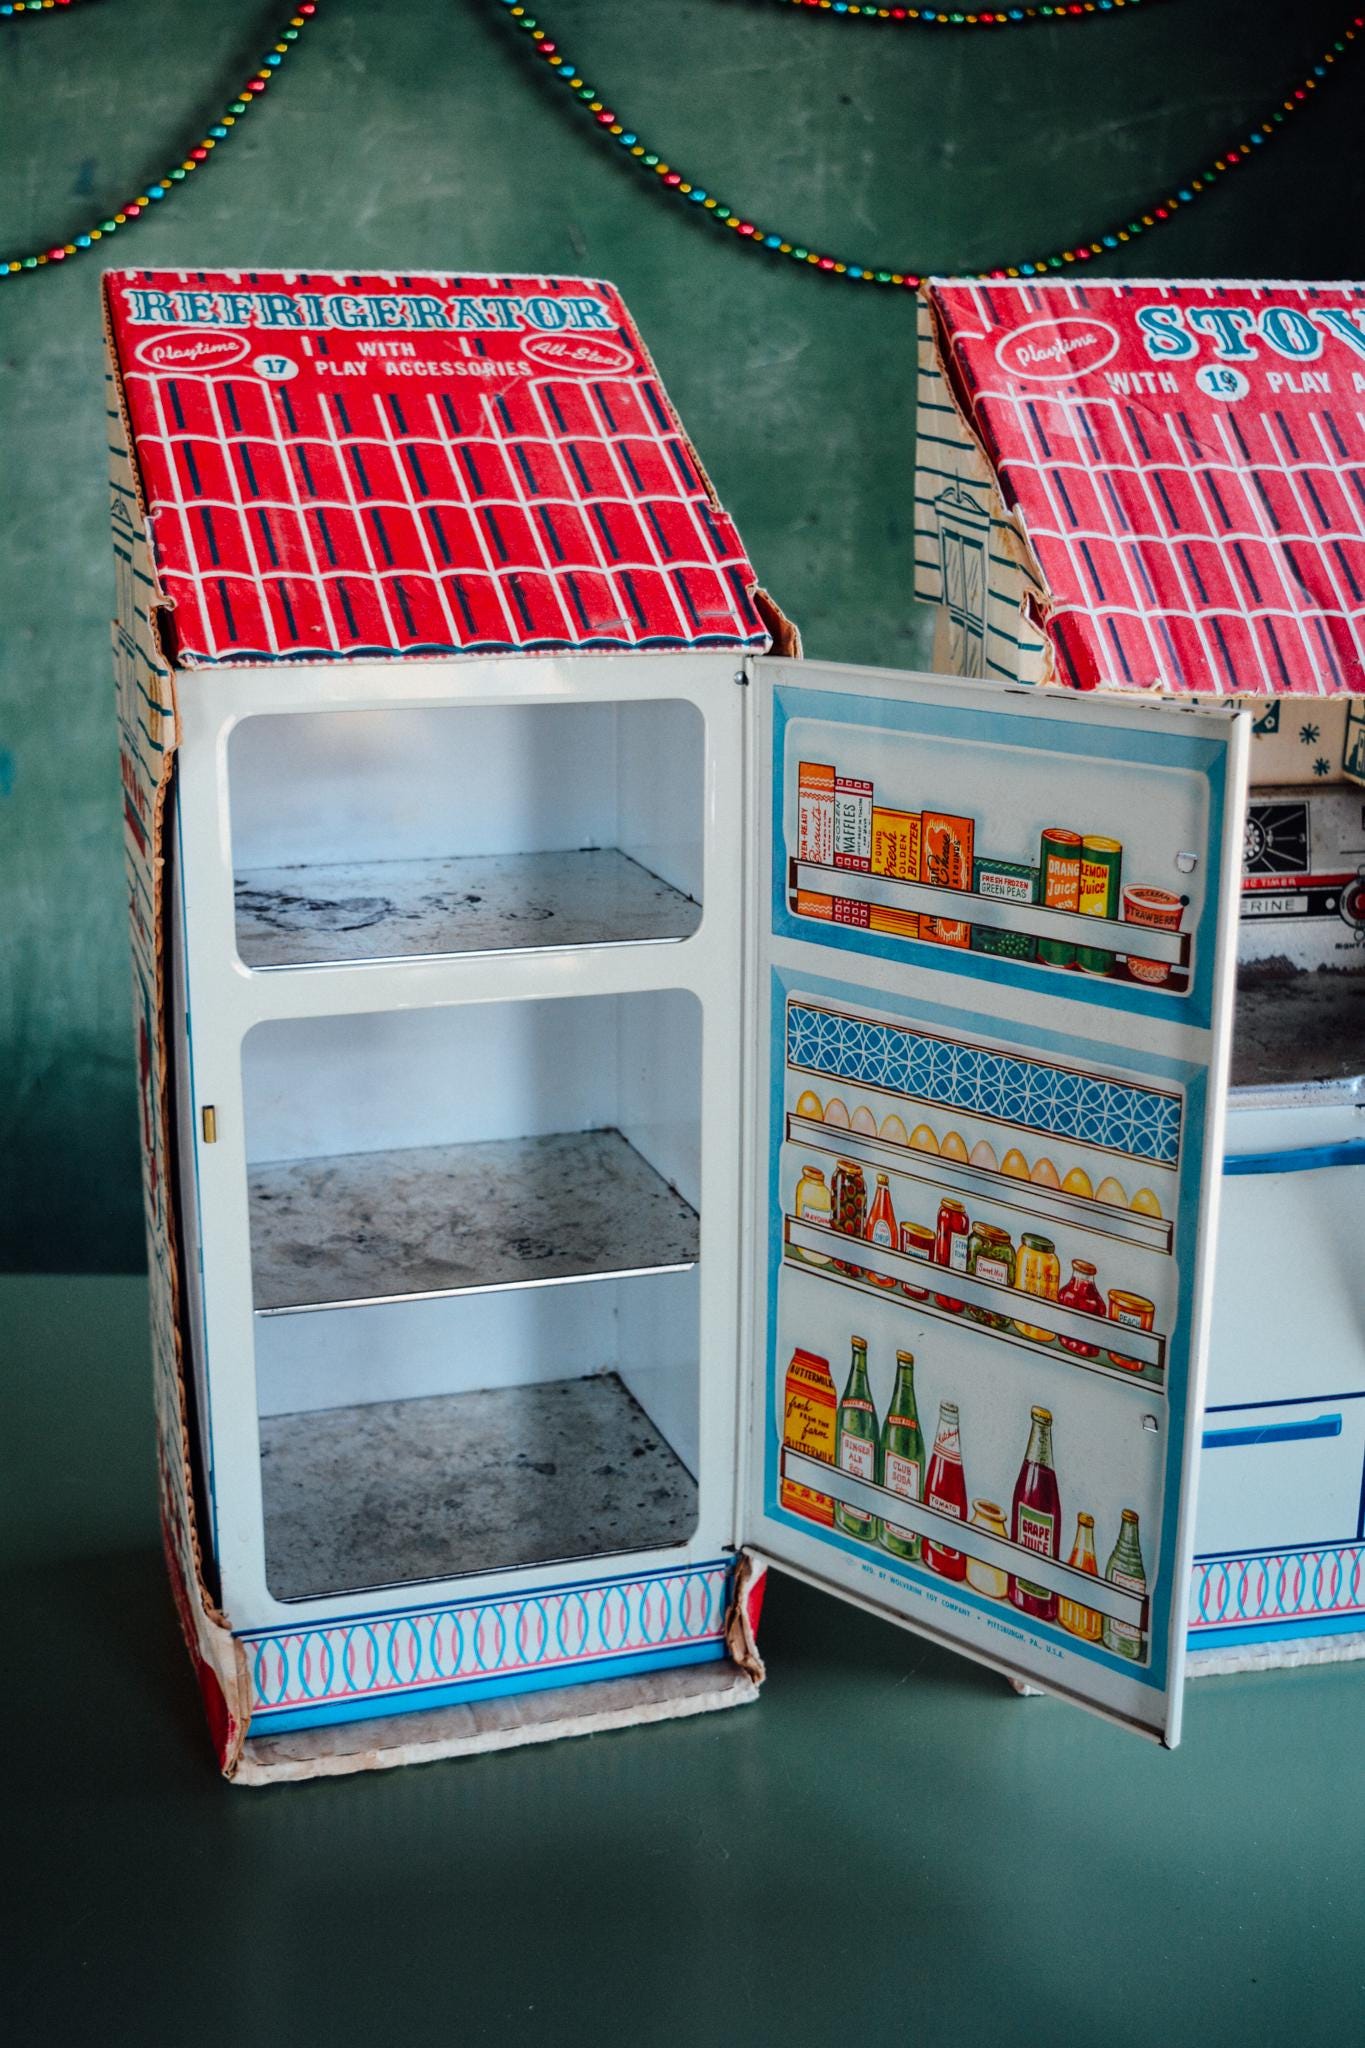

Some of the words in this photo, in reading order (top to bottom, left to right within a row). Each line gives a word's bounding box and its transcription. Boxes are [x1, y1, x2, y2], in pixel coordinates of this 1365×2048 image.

[123, 288, 622, 331] REFRIGERATOR
[152, 337, 240, 365] Playtime
[358, 341, 416, 358] WITH
[531, 342, 625, 367] All-Steel
[1015, 332, 1098, 367] Playtime
[263, 359, 287, 375] 17
[316, 360, 368, 377] PLAY
[384, 360, 534, 378] ACCESSORIES
[1104, 371, 1180, 395] WITH
[1205, 369, 1238, 394] 19
[1266, 371, 1332, 394] PLAY
[843, 804, 856, 853] WAFFLES
[899, 833, 907, 878] OLDEN
[907, 821, 918, 878] BUTTER
[1082, 863, 1108, 879] LEMON
[981, 882, 1005, 896] GREEN
[1006, 886, 1027, 899] PEAS
[982, 873, 1003, 885] FRESH
[1003, 877, 1029, 890] FROZEN
[1047, 878, 1077, 897] Juice
[1080, 877, 1106, 895] Juice
[790, 1364, 834, 1388] BUTTERMILK
[801, 1421, 829, 1441] farm
[844, 1439, 870, 1456] GINGER
[848, 1454, 863, 1464] ALE
[892, 1461, 912, 1475] CLUB
[892, 1472, 912, 1487] SODA
[931, 1495, 958, 1513] TOMATO
[1022, 1518, 1050, 1541] GRAPE
[1020, 1534, 1049, 1555] JUICE
[878, 1571, 887, 1579] BY
[925, 1591, 938, 1602] TOY
[941, 1600, 971, 1618] COMPANY
[986, 1618, 1027, 1642] PITTSBURGH,
